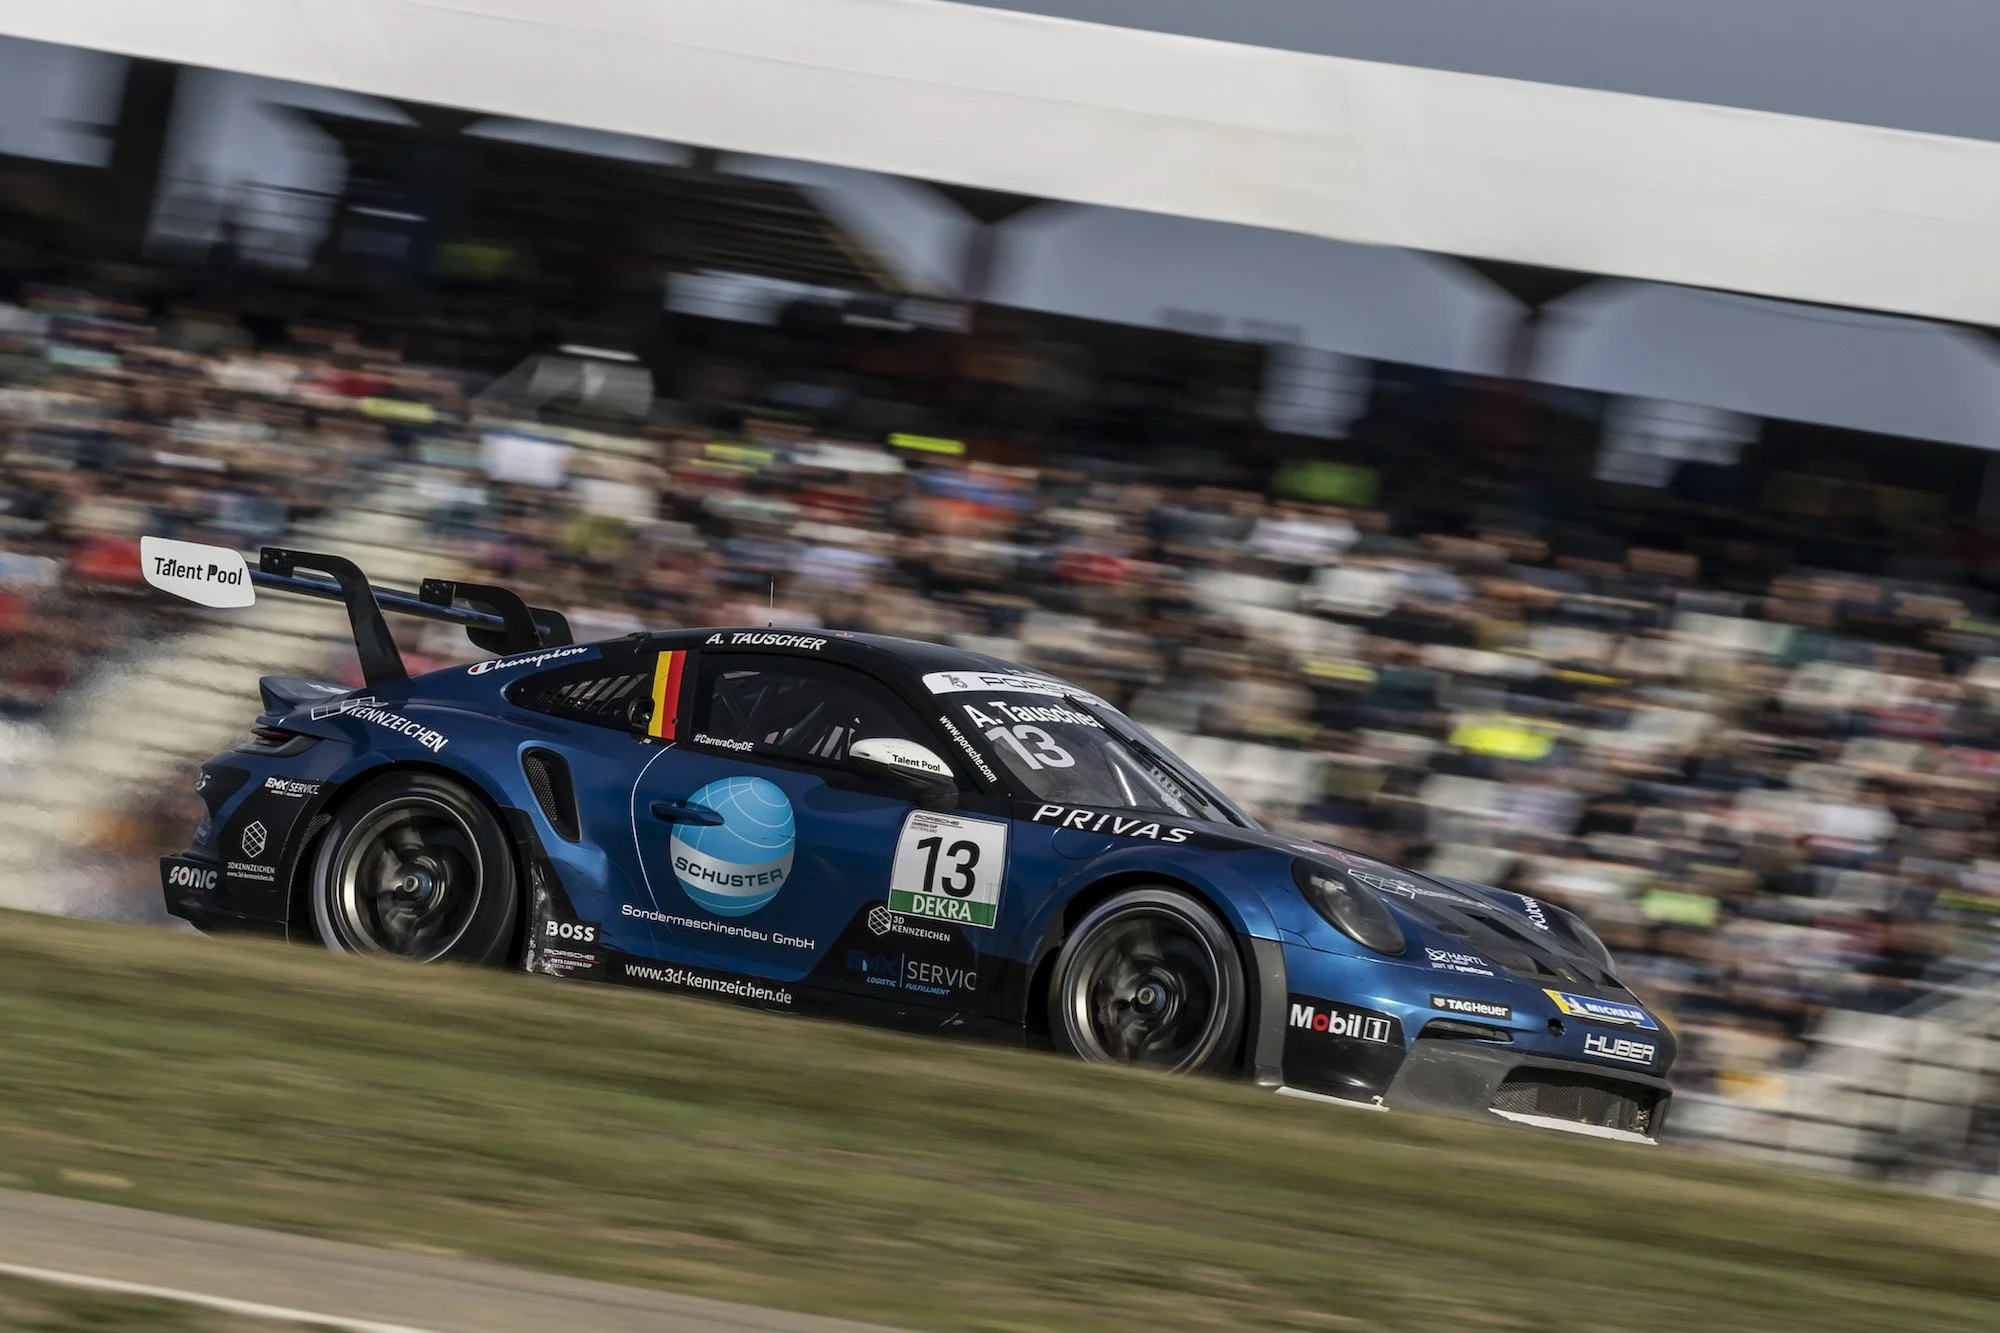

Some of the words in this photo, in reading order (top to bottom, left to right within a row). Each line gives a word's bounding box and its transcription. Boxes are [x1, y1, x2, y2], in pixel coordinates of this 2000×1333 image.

[154, 556, 203, 580] Talent
[206, 563, 243, 586] Pool
[706, 632, 725, 645] A.
[730, 632, 827, 651] TAUSCHER
[467, 646, 588, 676] Champion
[346, 706, 450, 753] KENNZEICHEN
[962, 703, 1004, 729] A.
[987, 700, 1106, 730] Tauscher
[693, 732, 755, 752] #CarreraCupDE
[939, 715, 998, 783] www.porsche.com
[984, 724, 1076, 770] 13
[892, 754, 920, 767] Talent
[921, 760, 941, 772] Pool
[264, 776, 290, 791] EMK
[288, 782, 321, 795] SERVICE
[1032, 804, 1195, 843] PRIVAS
[675, 856, 784, 887] SCHUSTER
[917, 836, 980, 898] 13
[893, 915, 905, 925] 3D
[911, 894, 973, 922] DEKRA
[545, 920, 595, 942] BOSS
[621, 904, 768, 942] Sondermaschinenbau
[772, 932, 816, 950] GmbH
[891, 924, 951, 942] KENNZEICHEN
[1446, 952, 1489, 967] HARTL
[624, 963, 793, 1005] www.3d-kennzeichen.de
[866, 976, 898, 988] LOGISTIC
[905, 982, 952, 996] FULFILLMENT
[1289, 1003, 1362, 1039] Mobil
[1585, 1003, 1646, 1021] MICHELIN
[1585, 1033, 1655, 1062] HUBER
